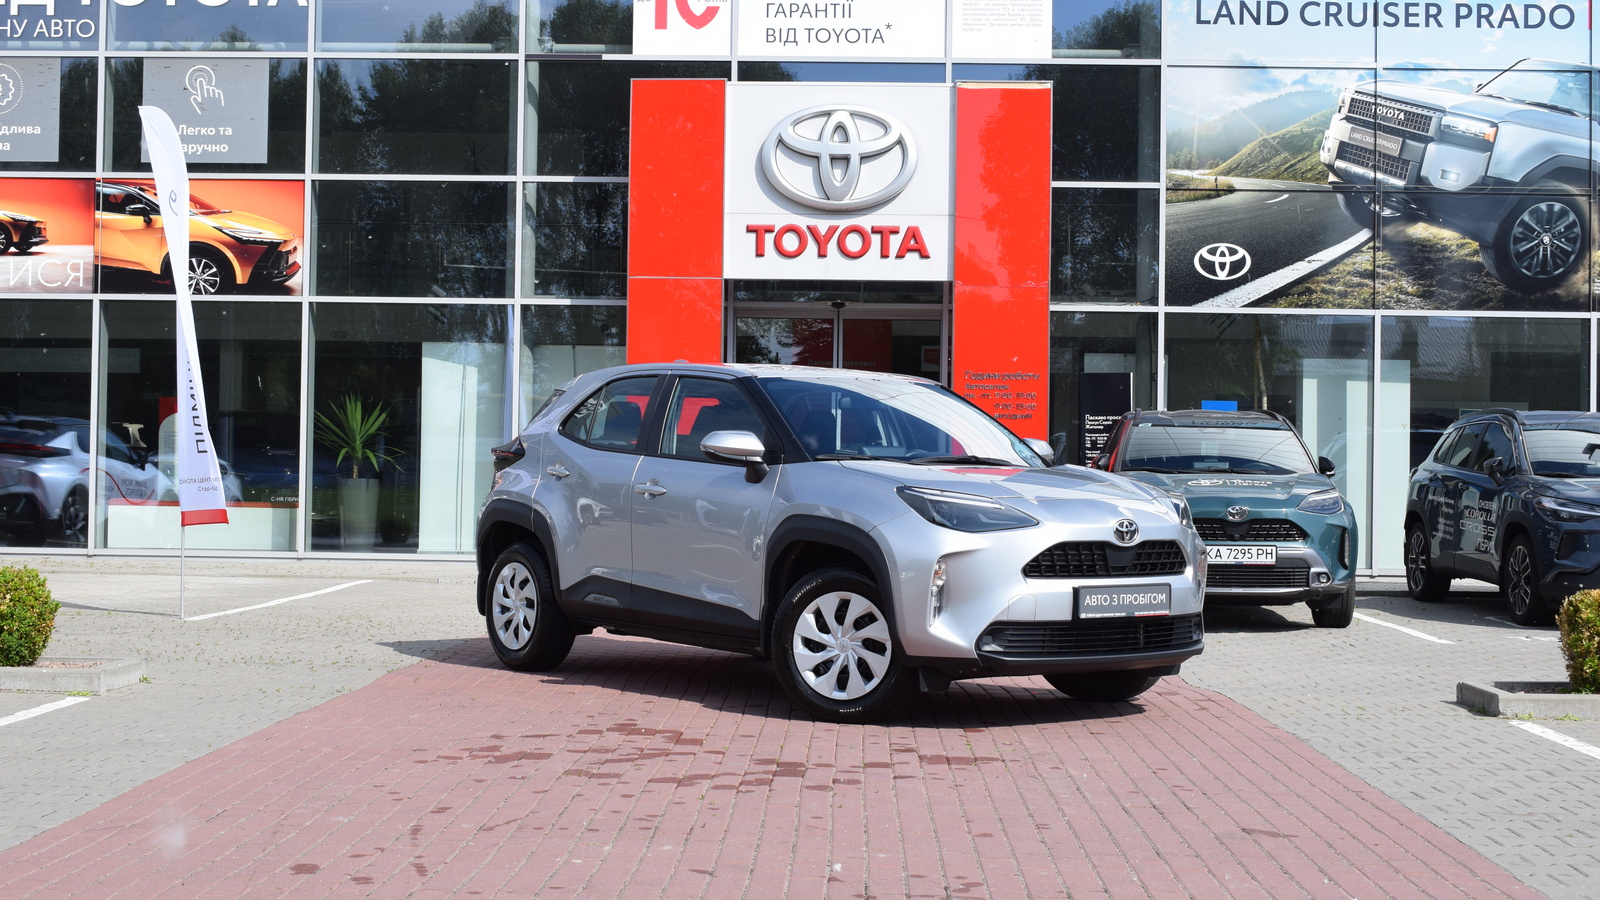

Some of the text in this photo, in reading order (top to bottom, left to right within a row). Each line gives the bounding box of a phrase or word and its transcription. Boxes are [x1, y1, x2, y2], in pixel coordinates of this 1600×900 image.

[765, 0, 853, 18] ГАРАНТІЇ
[1195, 0, 1576, 30] LAND CRUISER PRADO
[34, 19, 95, 38] АВТО
[765, 28, 798, 46] ВІД
[1371, 105, 1405, 121] TOYOTA
[177, 125, 233, 136] Легко та
[181, 144, 229, 155] зручно
[746, 224, 931, 259] TOYOTA
[0, 259, 84, 288] ИСЯ
[1466, 508, 1496, 522] COROLLA
[1459, 520, 1496, 536] CROSS
[1226, 548, 1253, 559] 7295
[1084, 594, 1110, 606] АВТО
[1120, 592, 1166, 605] ПРОБІГОМ
